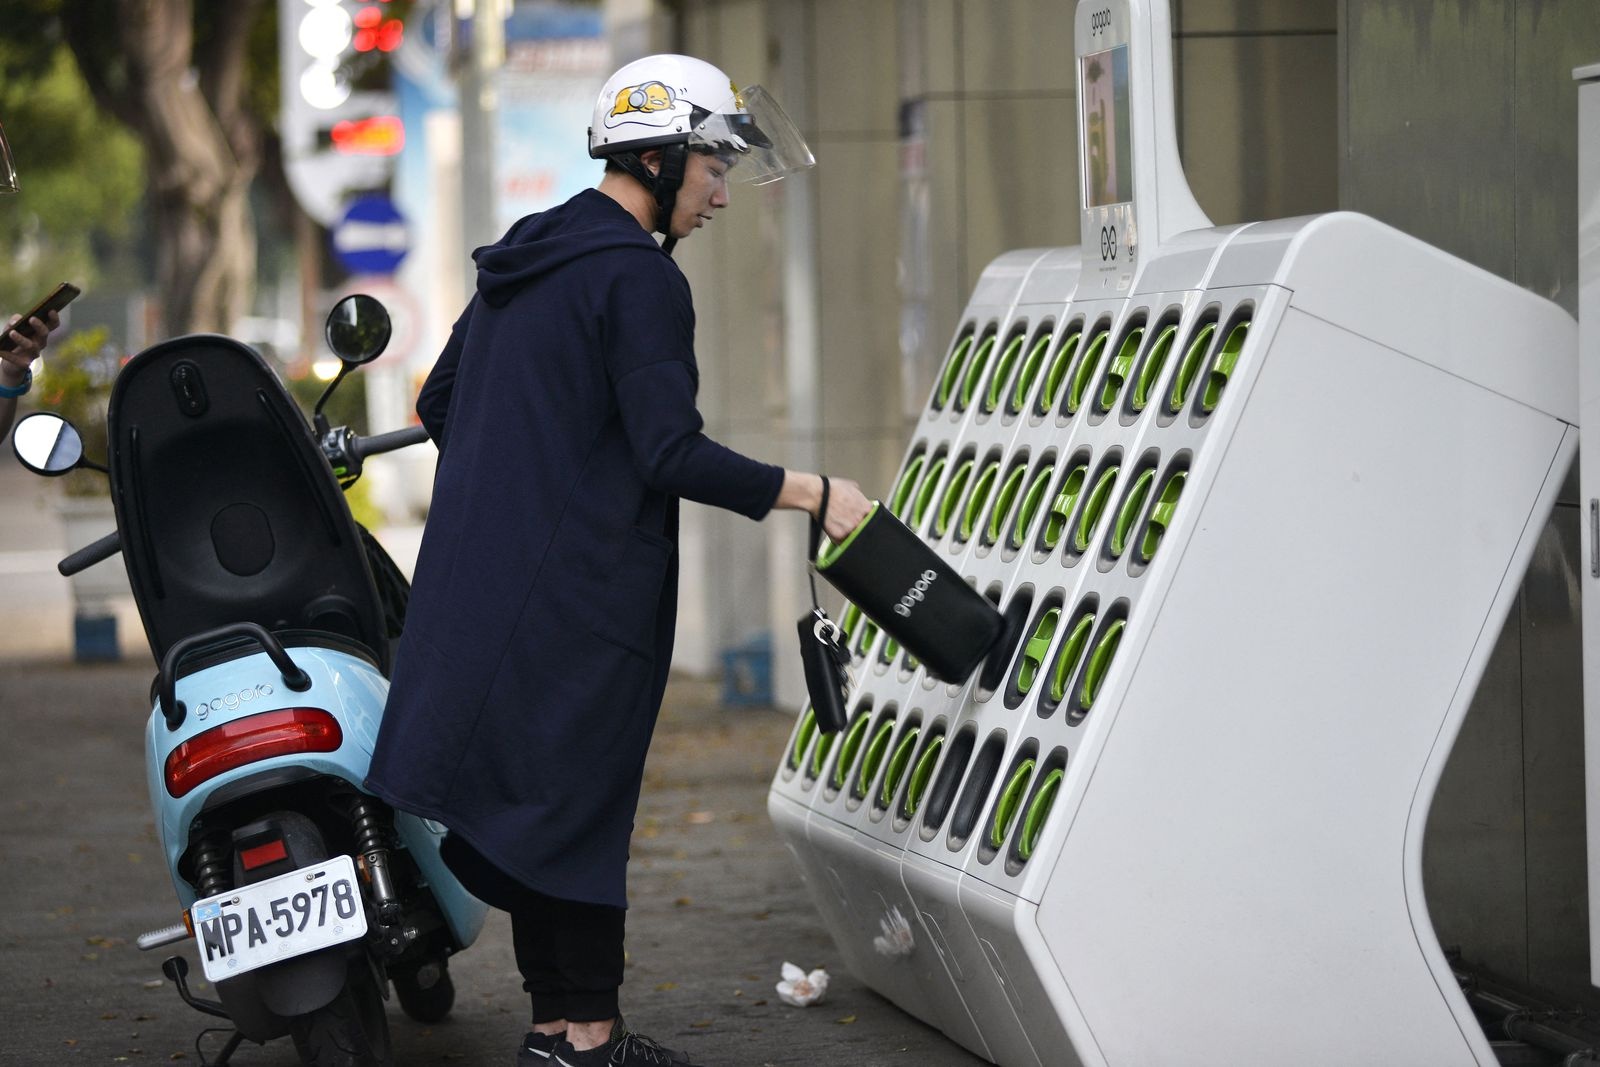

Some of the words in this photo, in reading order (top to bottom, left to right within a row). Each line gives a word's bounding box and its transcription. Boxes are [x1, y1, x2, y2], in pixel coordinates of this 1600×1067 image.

[1092, 8, 1112, 37] gogoro
[893, 569, 937, 618] gogoro
[195, 684, 274, 721] gogoro
